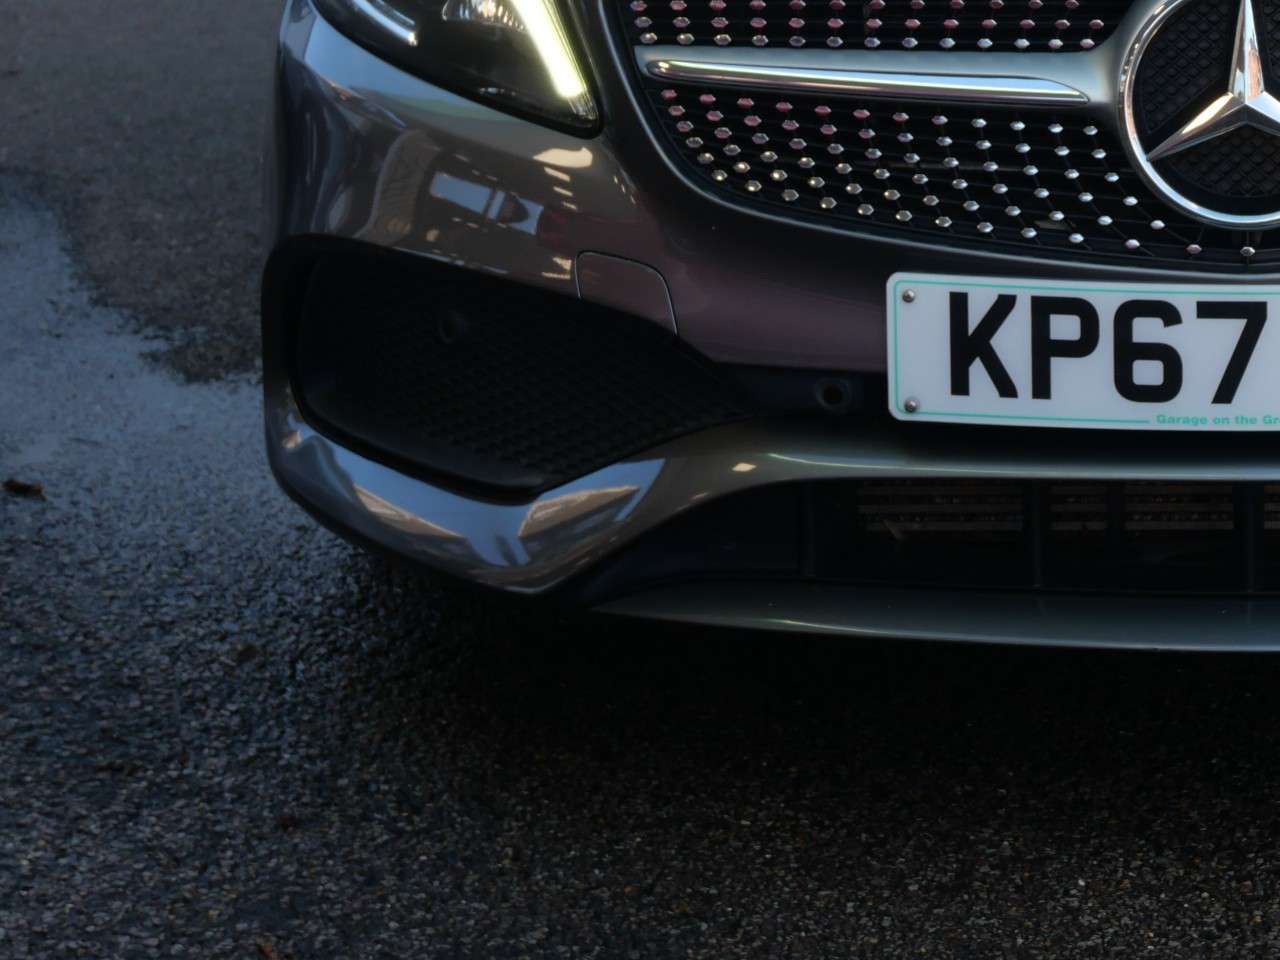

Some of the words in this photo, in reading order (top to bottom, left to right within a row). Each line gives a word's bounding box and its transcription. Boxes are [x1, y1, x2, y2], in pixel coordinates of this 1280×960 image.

[948, 291, 1268, 405] KP67
[1155, 414, 1207, 426] Garage
[1212, 416, 1231, 425] on
[1235, 414, 1257, 425] the
